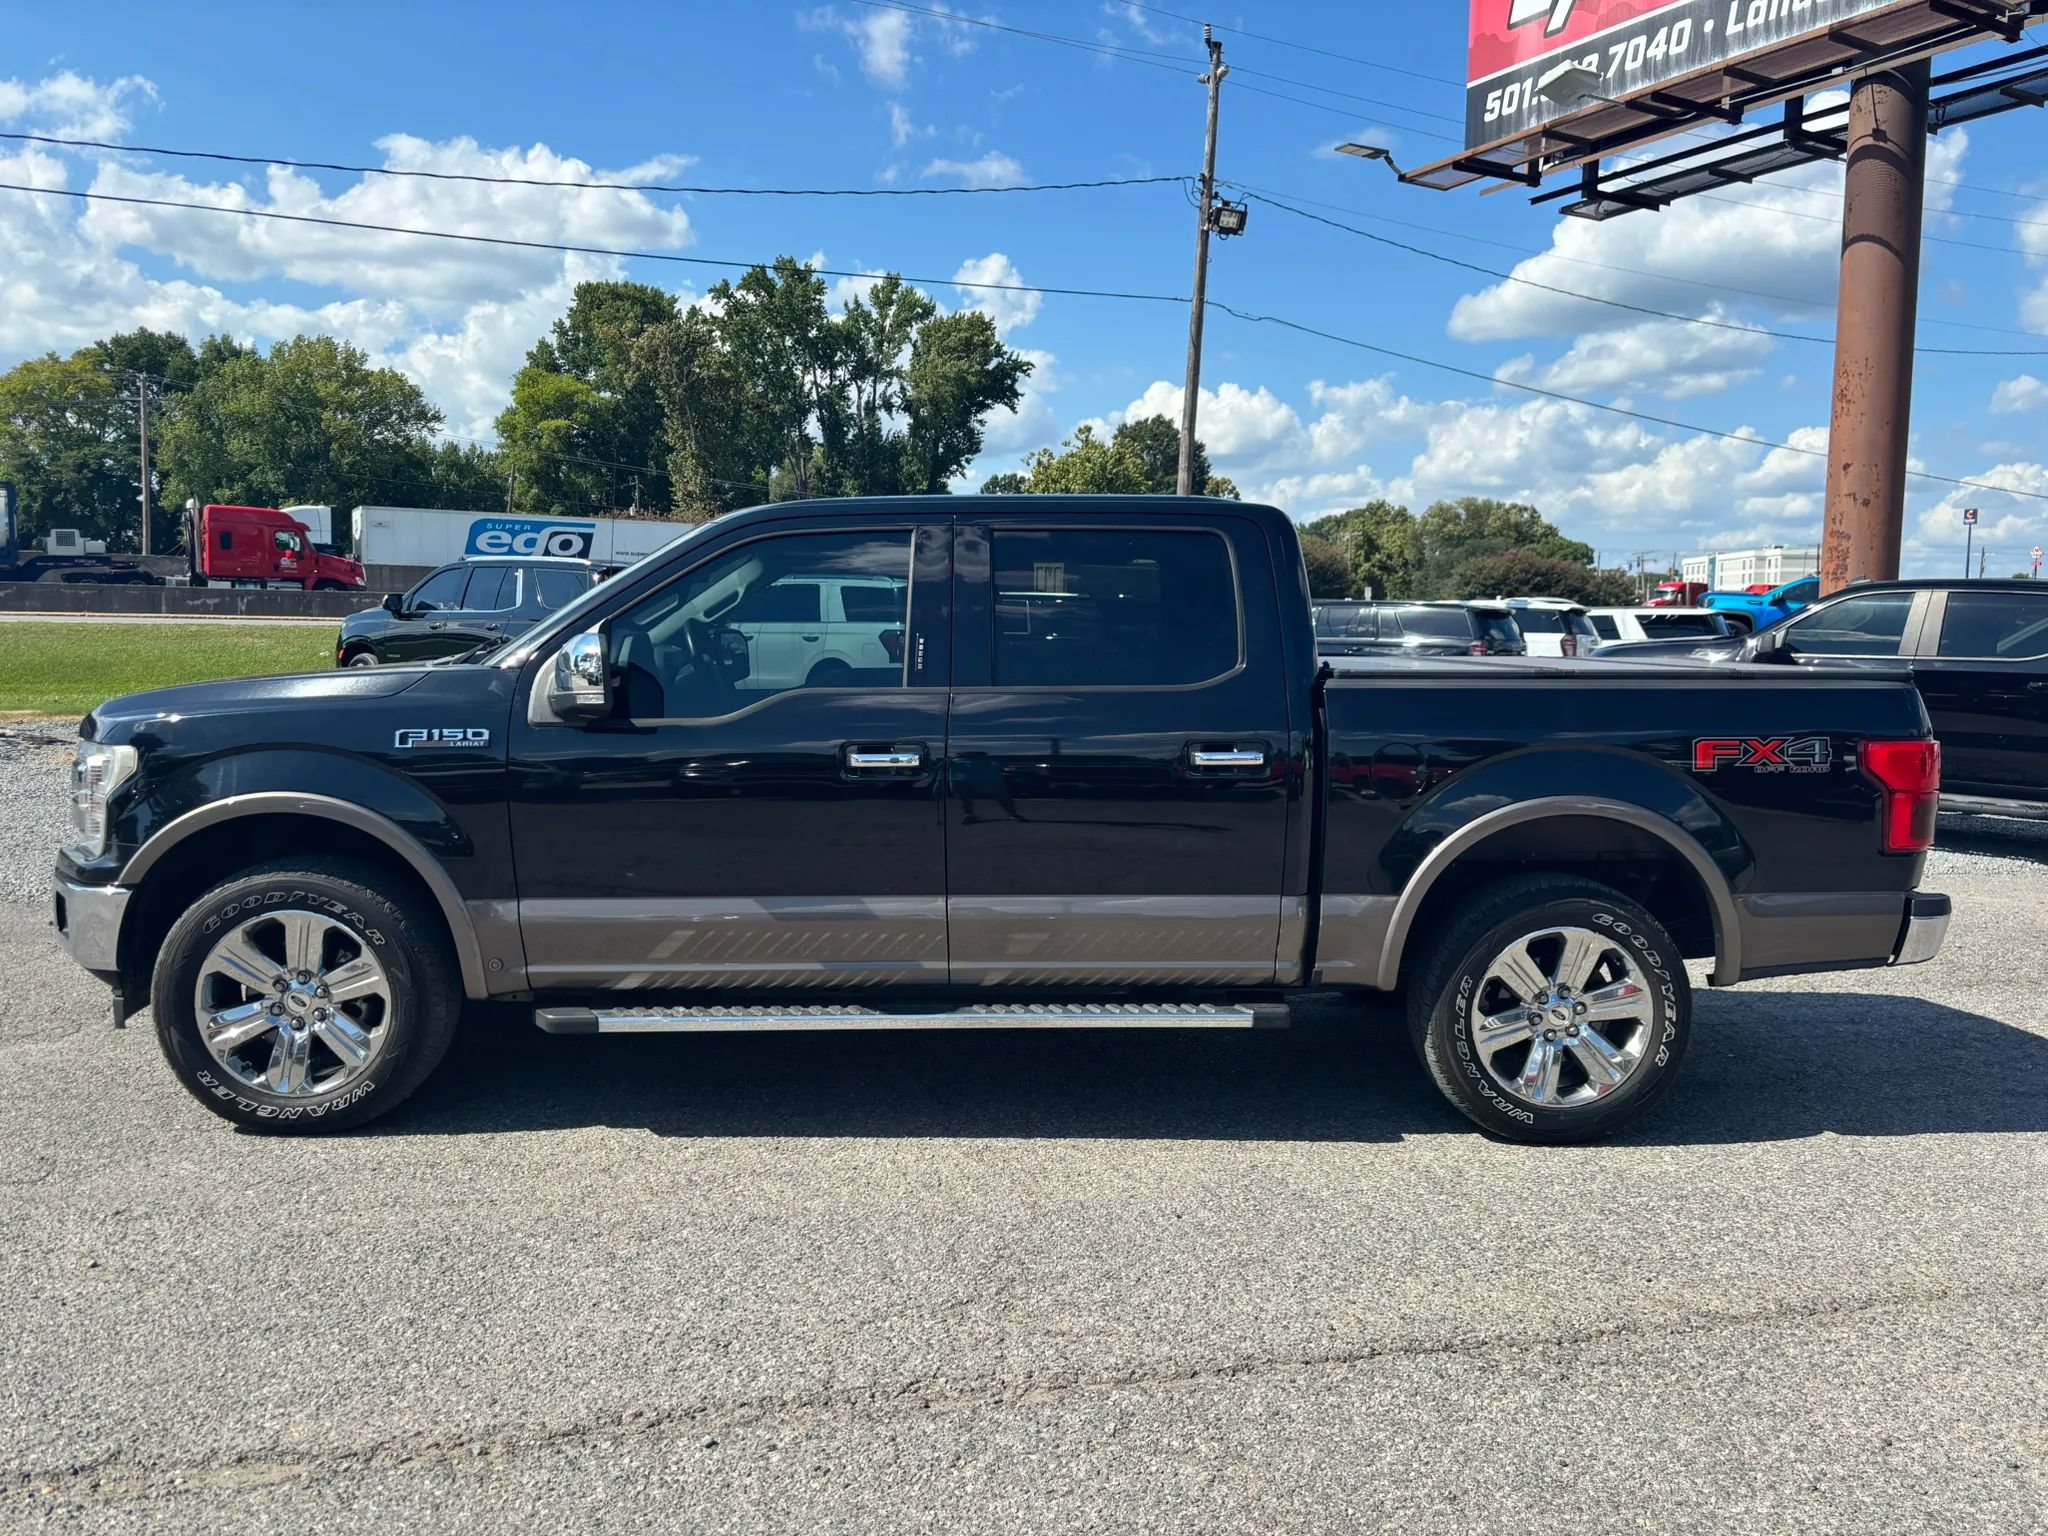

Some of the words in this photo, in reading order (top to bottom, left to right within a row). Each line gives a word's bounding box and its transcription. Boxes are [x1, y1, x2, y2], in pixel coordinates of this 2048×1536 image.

[1484, 18, 1692, 122] 501..7040
[476, 528, 584, 556] ego
[1692, 736, 1833, 772] FX4
[203, 891, 386, 946] GOODYEAR
[1592, 913, 1677, 1067] GOODYEAR
[1455, 975, 1534, 1124] WRANGLER
[197, 1070, 376, 1118] WRANGLER
